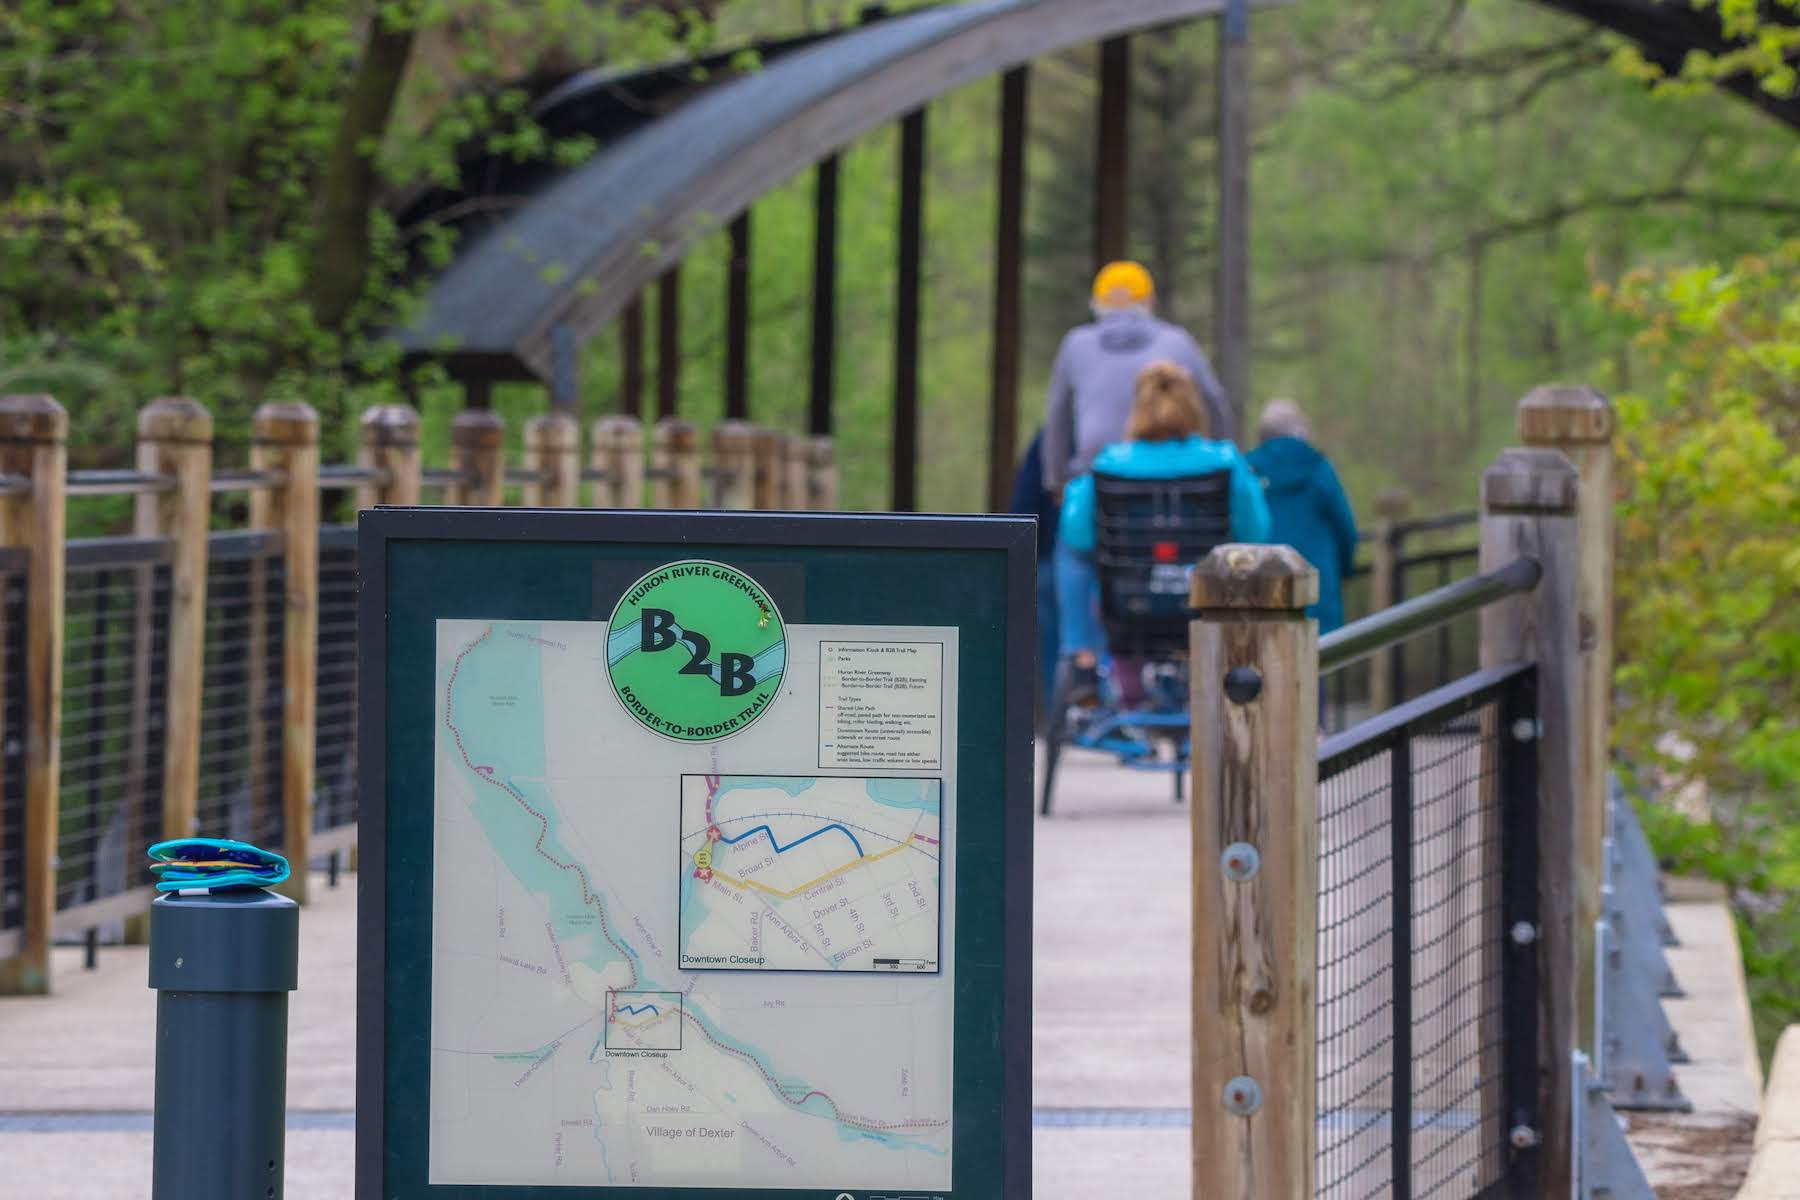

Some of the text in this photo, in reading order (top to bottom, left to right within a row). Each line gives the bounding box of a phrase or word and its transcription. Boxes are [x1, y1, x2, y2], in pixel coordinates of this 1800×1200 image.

[628, 572, 669, 606] HURON
[672, 566, 710, 578] RIVER
[641, 608, 757, 697] B2B
[620, 685, 769, 737] BORDER-TO-BORDER TRAIL
[732, 830, 768, 854] Alpine St
[738, 856, 774, 879] Broad St
[712, 880, 732, 897] Main
[804, 881, 834, 900] Central
[812, 897, 849, 920] Dover St
[751, 912, 759, 952] Baker Rd
[765, 907, 809, 953] Ann Arbor St
[682, 955, 765, 966] Downtown Closeup
[833, 939, 873, 962] Edison St
[646, 1127, 736, 1139] Village of Dexter
